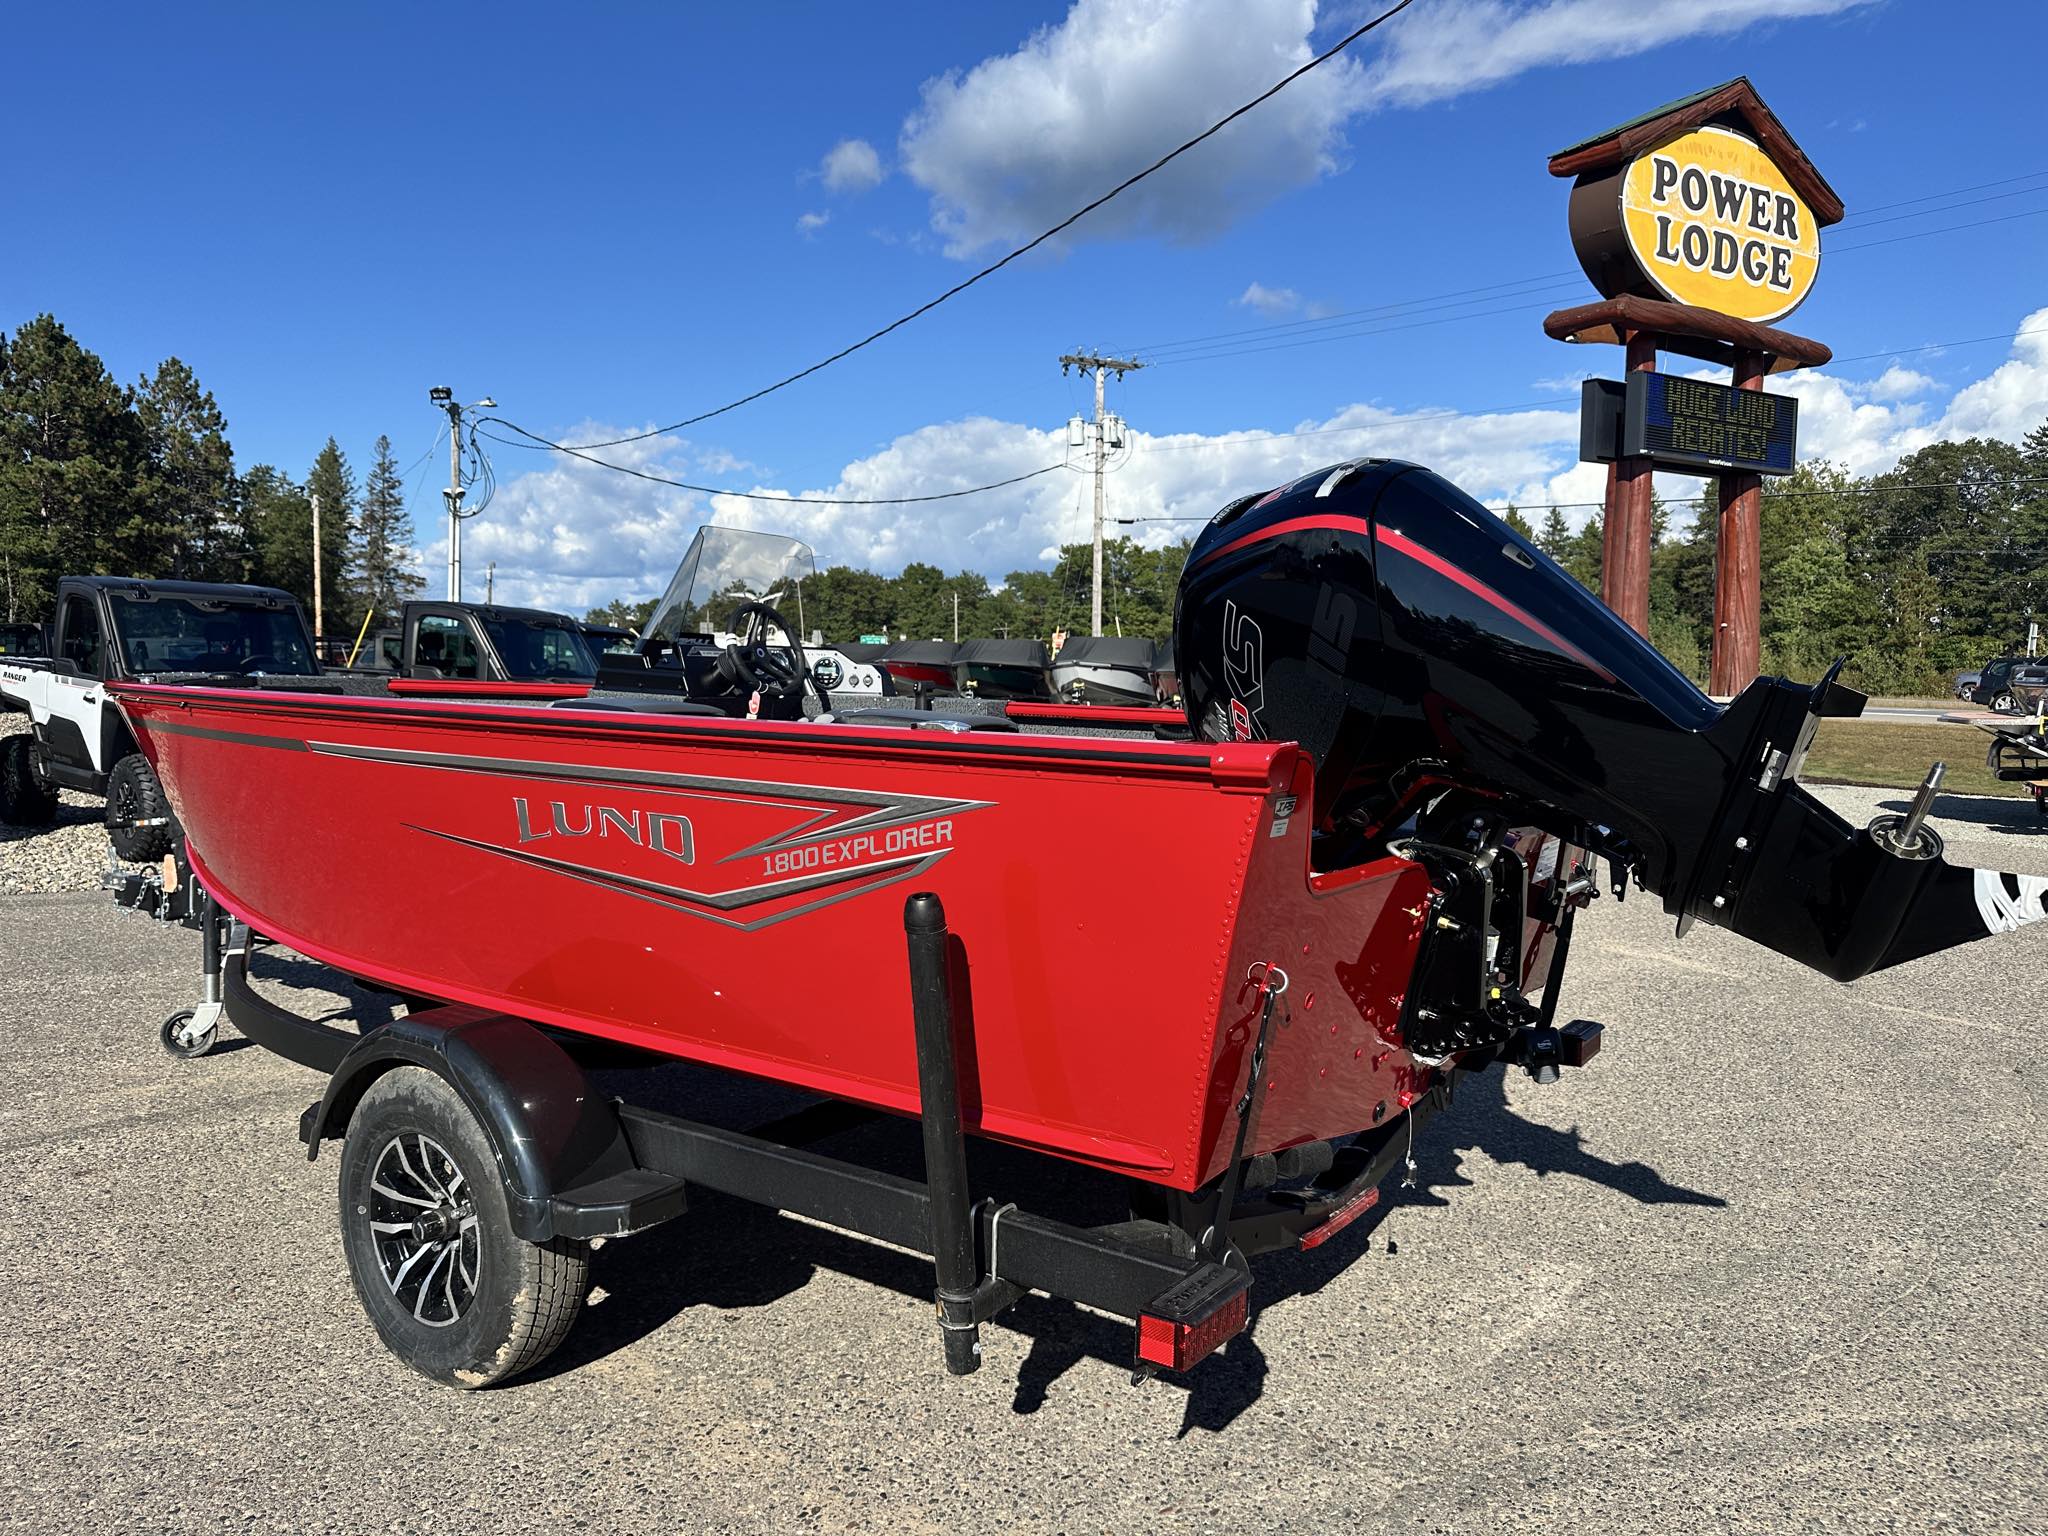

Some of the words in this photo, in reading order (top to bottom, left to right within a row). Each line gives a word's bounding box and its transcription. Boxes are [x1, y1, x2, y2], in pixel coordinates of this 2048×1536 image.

[1652, 156, 1799, 241] POWER
[1655, 214, 1793, 290] LODGE
[1666, 379, 1722, 421] HUGE
[1725, 389, 1777, 430] LUND
[2, 671, 27, 683] RANGER
[512, 795, 696, 866] LUND
[762, 846, 820, 876] 1800
[821, 819, 955, 866] EXPLORER
